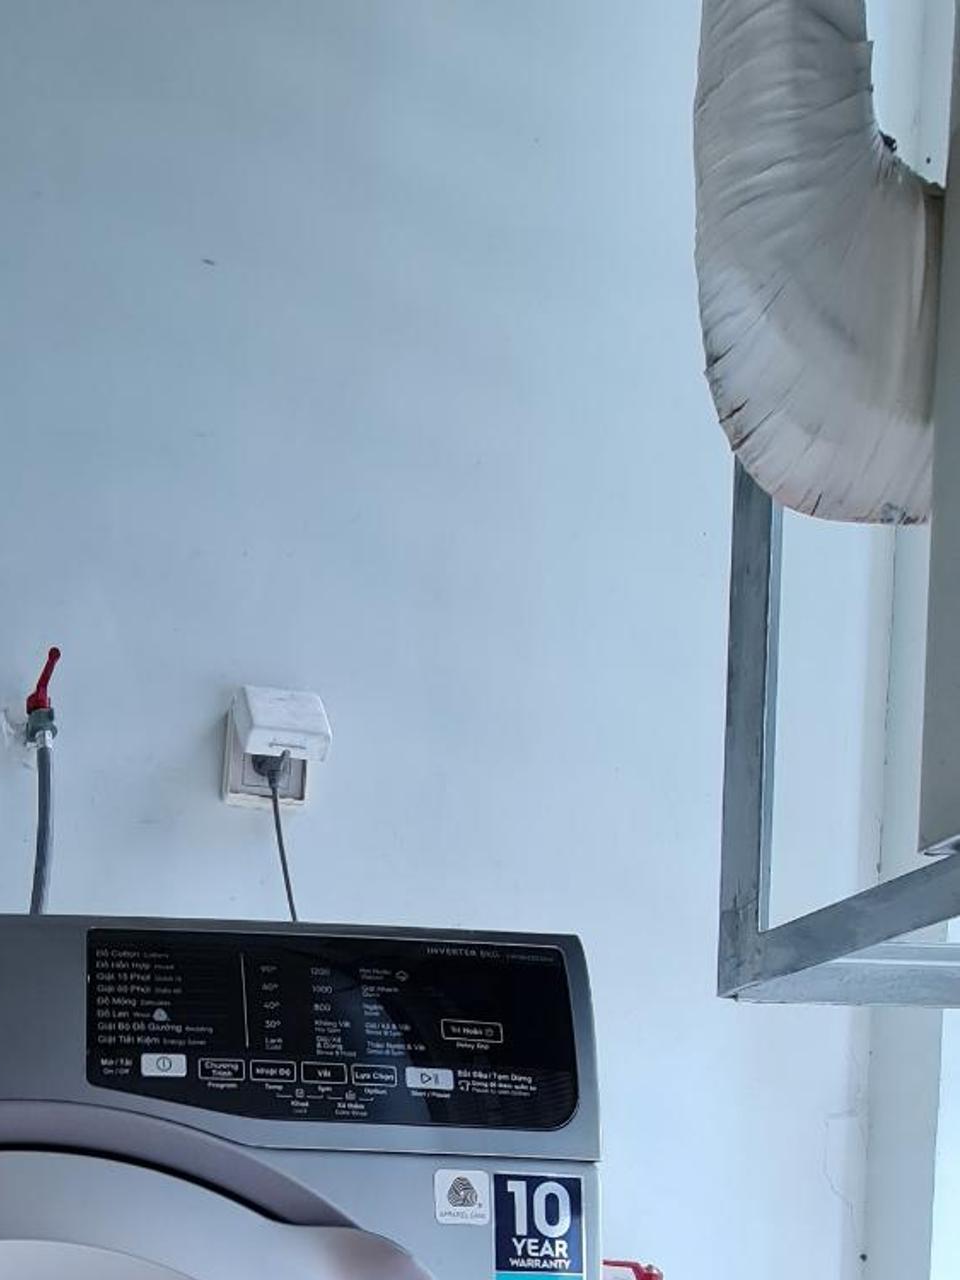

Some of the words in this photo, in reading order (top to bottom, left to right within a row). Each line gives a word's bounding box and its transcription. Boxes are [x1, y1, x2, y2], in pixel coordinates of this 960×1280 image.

[507, 1180, 572, 1239] 10
[511, 1238, 569, 1258] YEAR
[509, 1258, 572, 1270] WARRANTY
